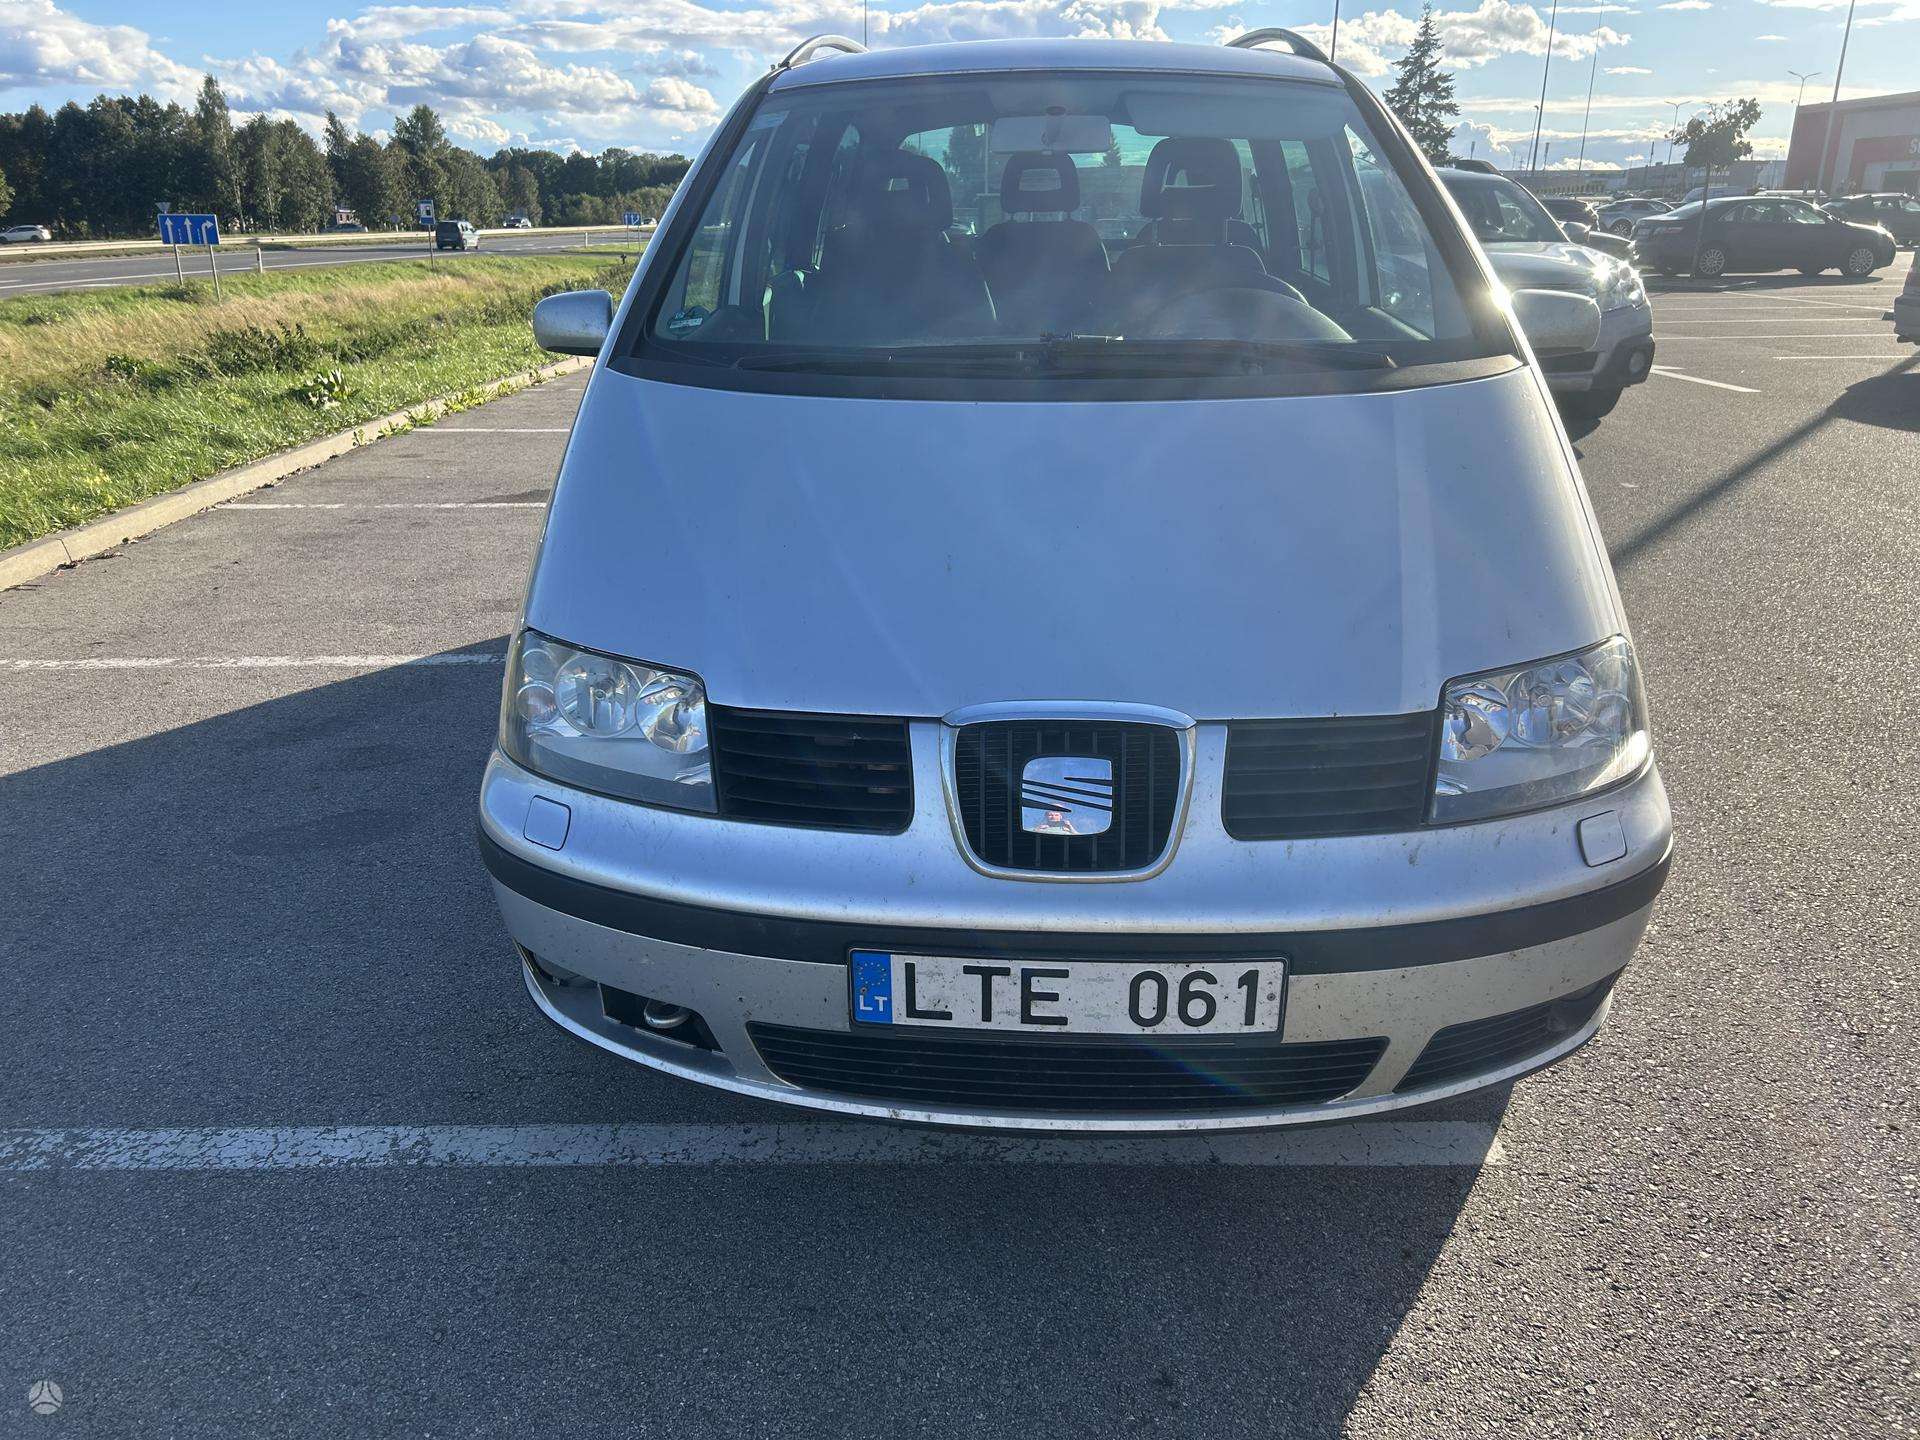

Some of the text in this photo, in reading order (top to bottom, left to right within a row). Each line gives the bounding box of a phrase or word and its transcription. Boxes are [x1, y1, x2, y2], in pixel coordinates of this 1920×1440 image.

[859, 994, 888, 1012] LT
[904, 962, 1260, 1028] LTE 061
